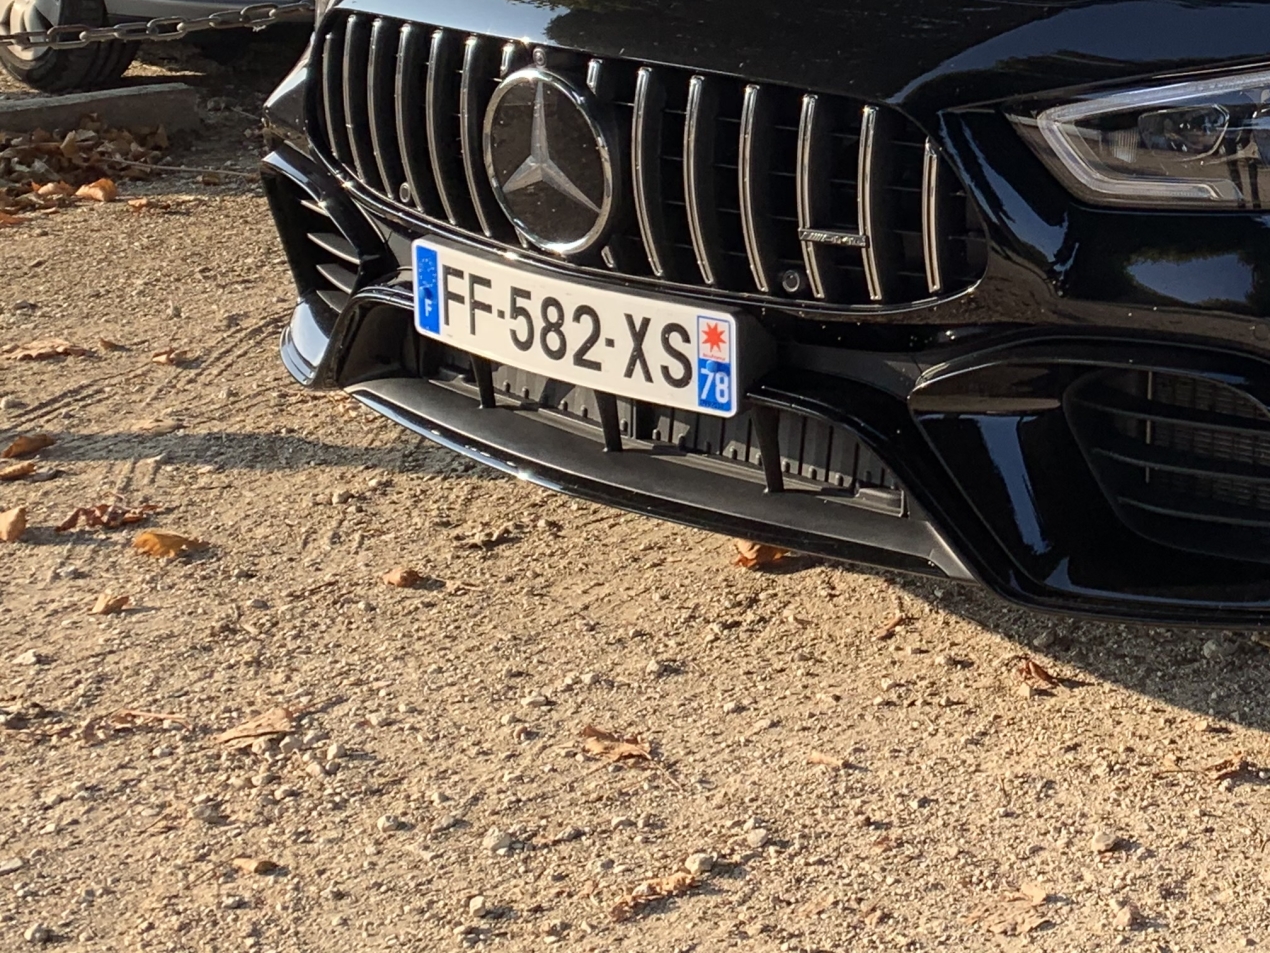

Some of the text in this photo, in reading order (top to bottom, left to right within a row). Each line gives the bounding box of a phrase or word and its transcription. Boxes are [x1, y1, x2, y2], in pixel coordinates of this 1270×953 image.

[425, 299, 432, 317] F
[442, 264, 693, 389] FF-582-XS
[700, 367, 729, 404] 78
